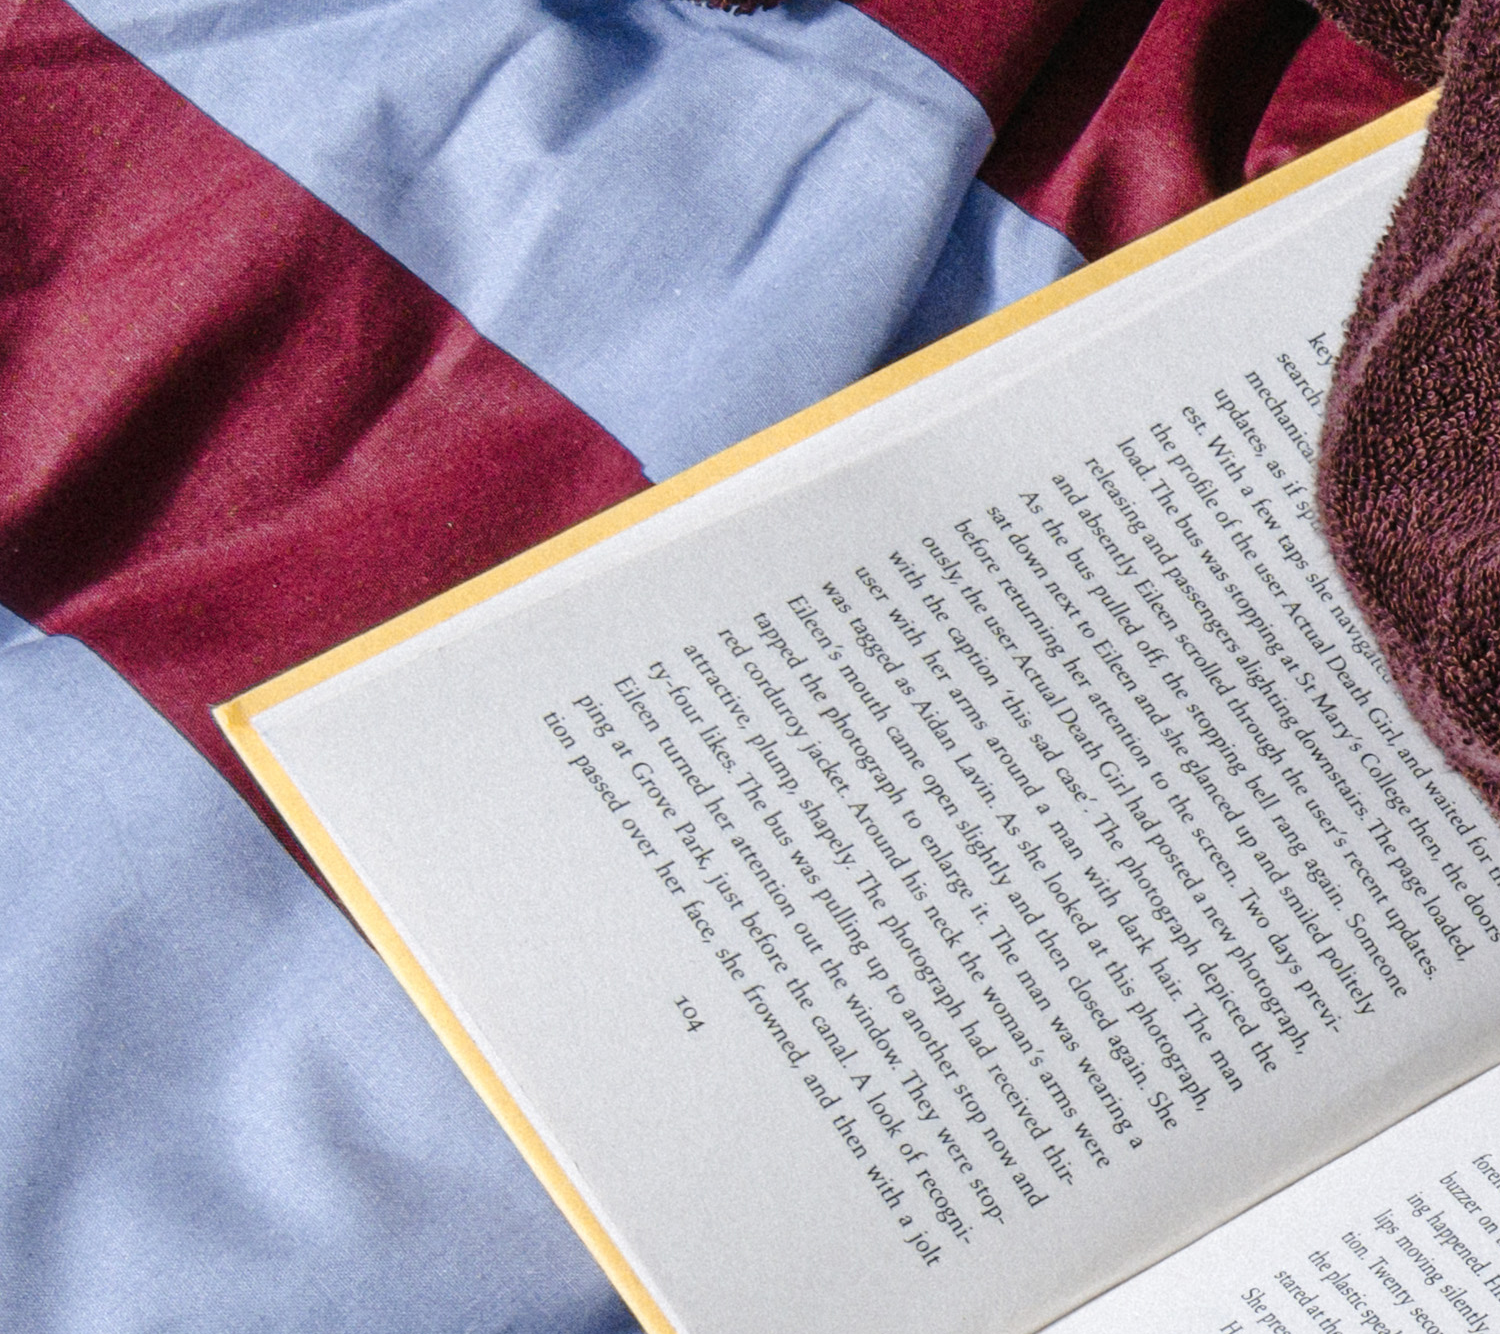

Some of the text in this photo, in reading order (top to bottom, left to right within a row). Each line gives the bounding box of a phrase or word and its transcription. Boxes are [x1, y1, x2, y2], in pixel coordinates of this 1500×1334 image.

[1180, 404, 1208, 438] est.
[1206, 433, 1248, 485] With
[1238, 484, 1255, 499] a
[1249, 497, 1283, 532] few
[1276, 533, 1311, 572] taps
[1304, 572, 1334, 603] she
[1212, 386, 1268, 459] updates,
[1264, 459, 1287, 481] as
[1280, 479, 1307, 498] if
[1243, 369, 1322, 464] mechanica
[1275, 351, 1326, 408] search
[920, 535, 1311, 1056] ously, the user Actual Death Girl had posted a new photograph,
[985, 505, 1377, 1016] sat down next to Eileen and she glanced up and smiled politely
[1083, 456, 1477, 963] releasing and passengers alighting downstairs. The page loaded,
[1148, 421, 1178, 453] the
[1165, 452, 1220, 510] profile
[1213, 509, 1244, 531] of
[1229, 530, 1259, 562] the
[1252, 561, 1289, 599] user
[1280, 601, 1337, 657] Actual
[1324, 653, 1374, 709] Death
[1366, 705, 1406, 748] Girl,
[1395, 747, 1435, 781] and
[1423, 778, 1479, 838] waited
[1465, 834, 1494, 865] for
[541, 710, 943, 1269] tion passed over her face, she frowned, and then with a jolt
[612, 674, 1006, 1226] Eileen turned her attention out the window. They were stop-
[673, 994, 707, 1034] 104
[682, 644, 1074, 1187] attractive, plump, shapely. The photograph had received thir-
[1239, 1286, 1269, 1315] She
[1372, 1207, 1401, 1236] lips
[1394, 1234, 1445, 1287] moving
